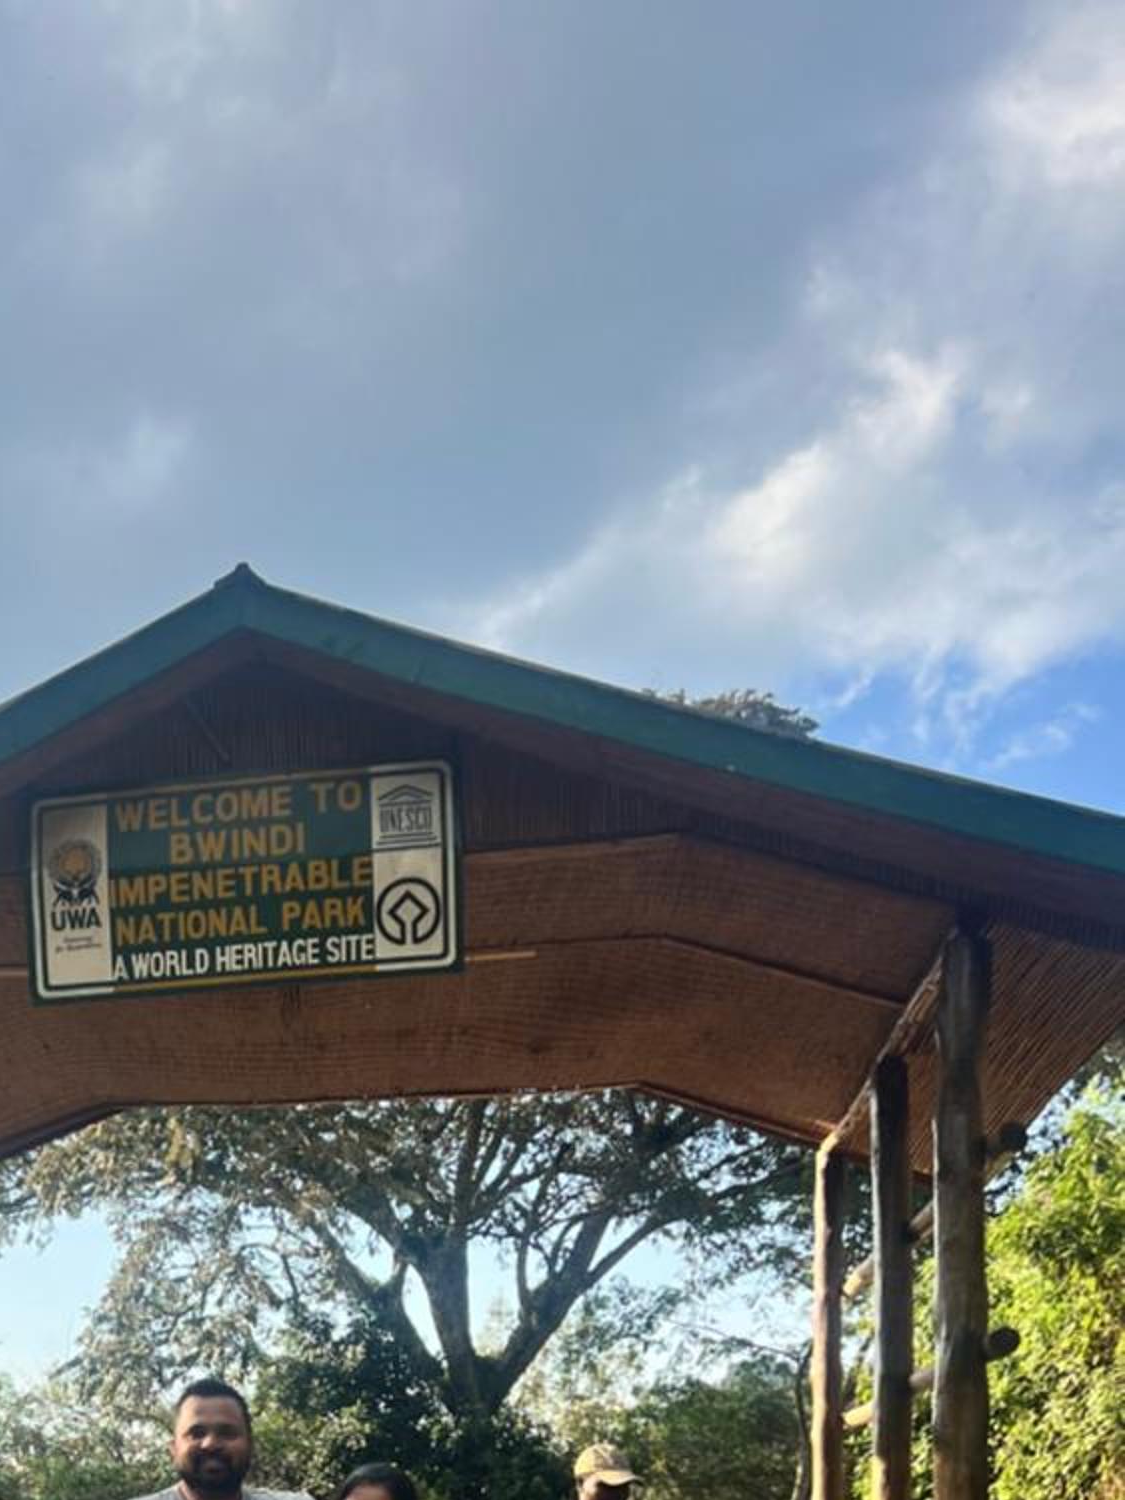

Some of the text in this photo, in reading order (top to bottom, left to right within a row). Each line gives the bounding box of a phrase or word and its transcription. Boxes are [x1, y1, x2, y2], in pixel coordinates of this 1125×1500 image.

[116, 779, 362, 833] WELCOME TO
[379, 805, 432, 832] UNESCO
[170, 822, 305, 865] BWINDI
[109, 857, 373, 908] IMPENETRABLE
[51, 906, 103, 931] UWA
[116, 896, 365, 947] NATIONAL PARK
[113, 933, 374, 980] A WORLD HERITAGE SITE
